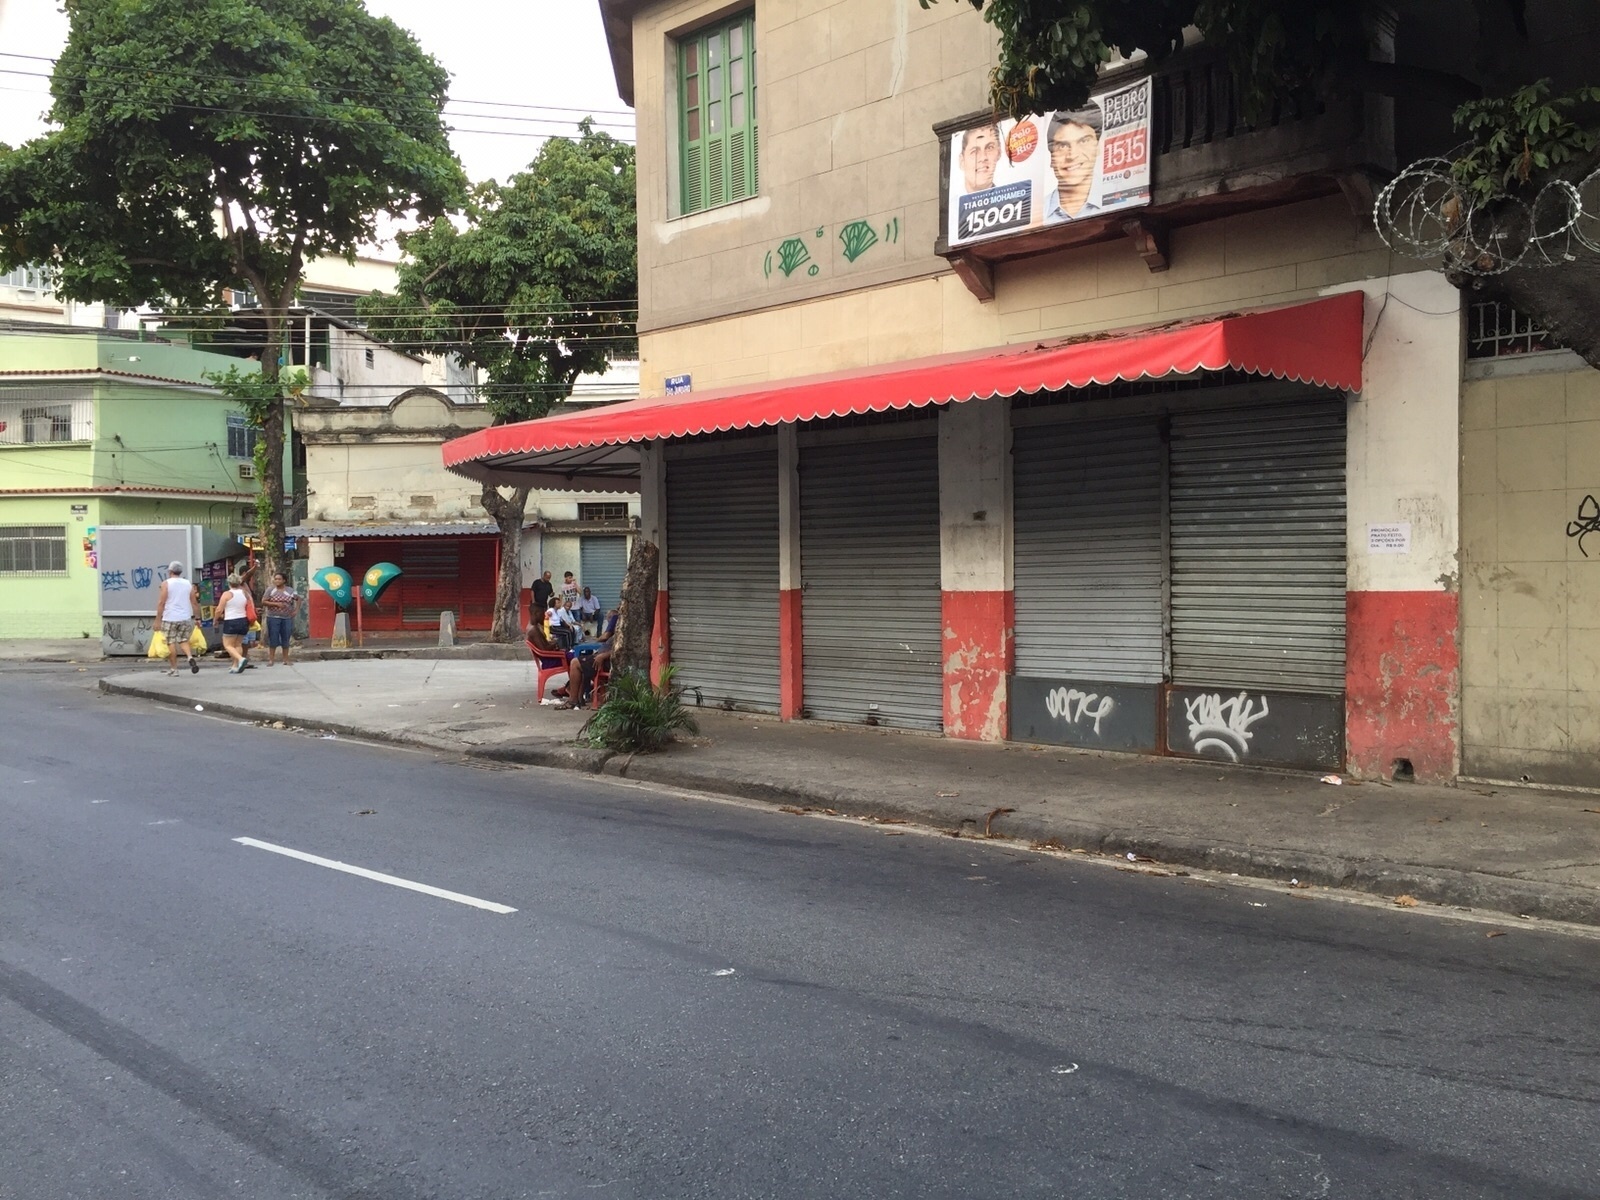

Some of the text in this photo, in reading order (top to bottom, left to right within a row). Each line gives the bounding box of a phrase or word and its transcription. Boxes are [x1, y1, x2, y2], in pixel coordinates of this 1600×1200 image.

[1106, 87, 1146, 112] PEDRO
[1106, 102, 1145, 127] PAULO
[1017, 143, 1032, 156] Rio
[1106, 134, 1145, 168] 1515
[964, 189, 1026, 210] TIAGO MOHAMED
[966, 200, 1023, 233] 15001
